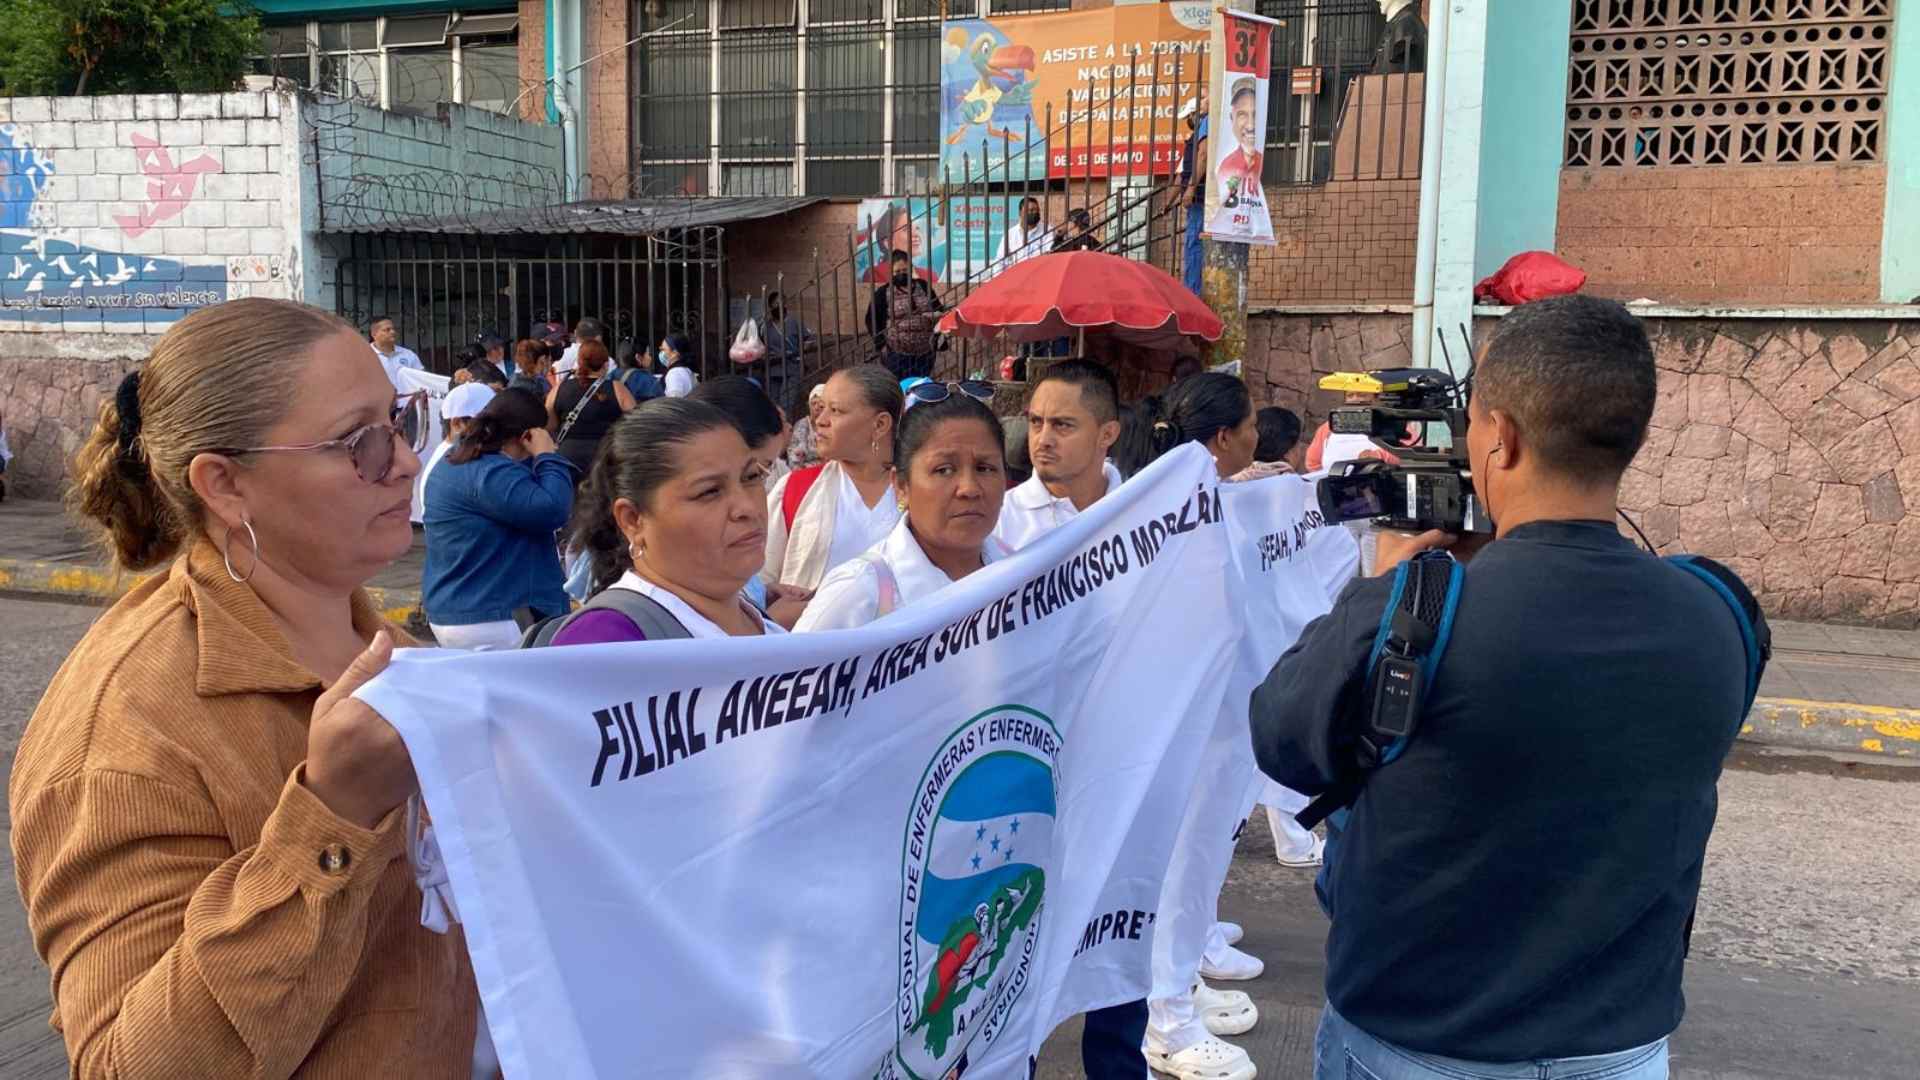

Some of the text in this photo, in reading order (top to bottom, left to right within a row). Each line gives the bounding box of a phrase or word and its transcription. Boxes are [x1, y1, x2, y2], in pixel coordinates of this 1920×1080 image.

[1042, 39, 1211, 64] ASISTE A LA JORNAD
[1078, 62, 1185, 81] NACONAL DE
[1179, 83, 1191, 97] Y
[1094, 152, 1108, 165] DE
[590, 687, 707, 788] FILIAL
[716, 655, 861, 744] ANEEAH,
[935, 608, 985, 662] SUR
[986, 590, 1018, 641] DE
[1021, 534, 1129, 626] FRANCISCO
[978, 723, 987, 746] Y
[990, 717, 1061, 758] ENFERMER
[910, 730, 976, 860] ENFERMERAS
[906, 865, 920, 902] DE
